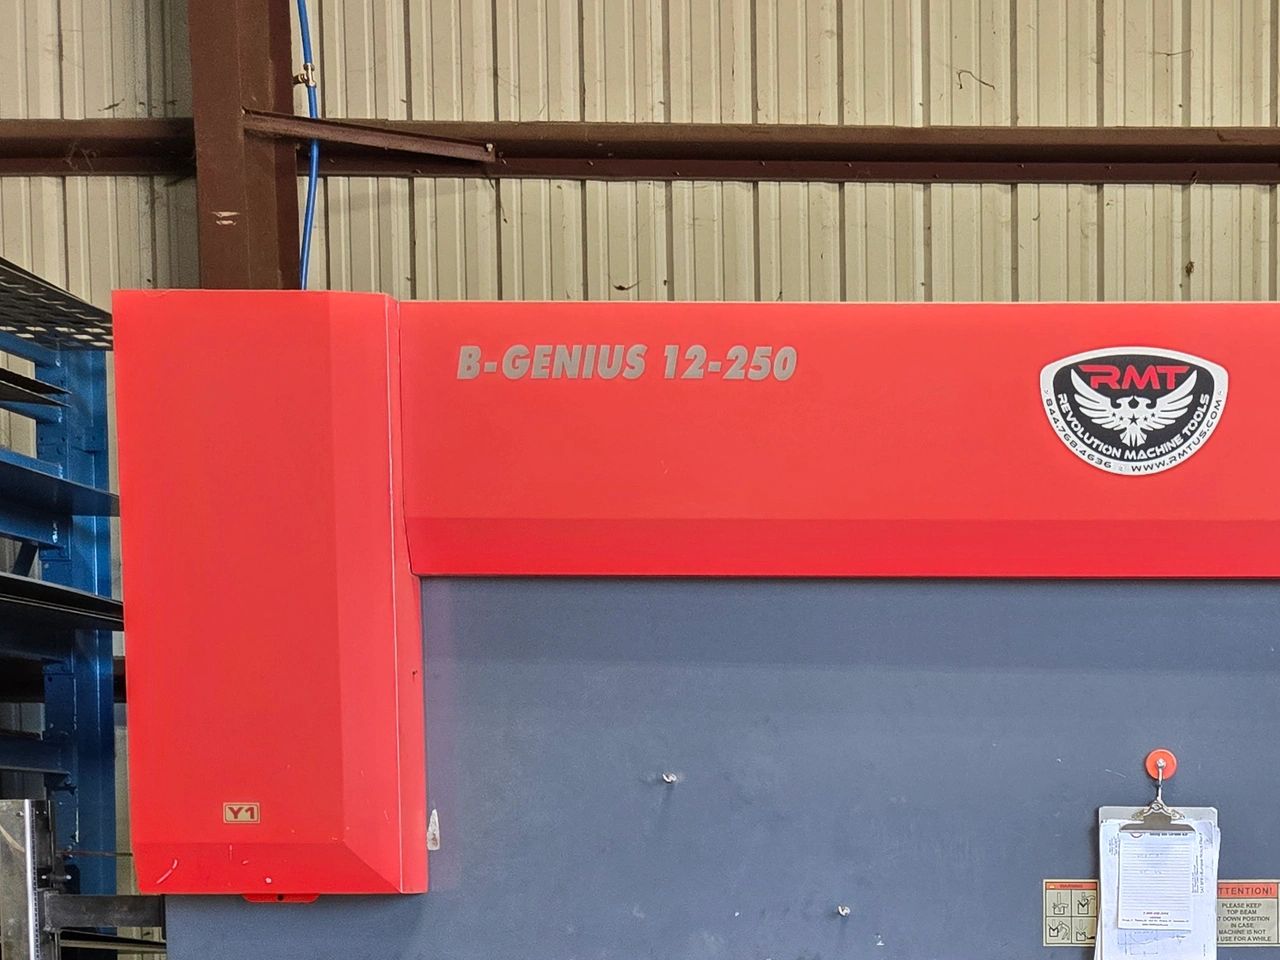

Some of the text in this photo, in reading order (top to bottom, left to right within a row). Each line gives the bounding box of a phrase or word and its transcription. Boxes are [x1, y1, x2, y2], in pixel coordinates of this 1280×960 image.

[456, 344, 798, 381] B-GENIUS 12-250
[1078, 364, 1191, 390] RMT
[1057, 393, 1211, 461] REVOLUTION MACHINE TOOLS
[1131, 399, 1223, 473] WWW.RMTUS.COM
[227, 806, 255, 820] Y1
[1217, 887, 1272, 896] TTENTION!
